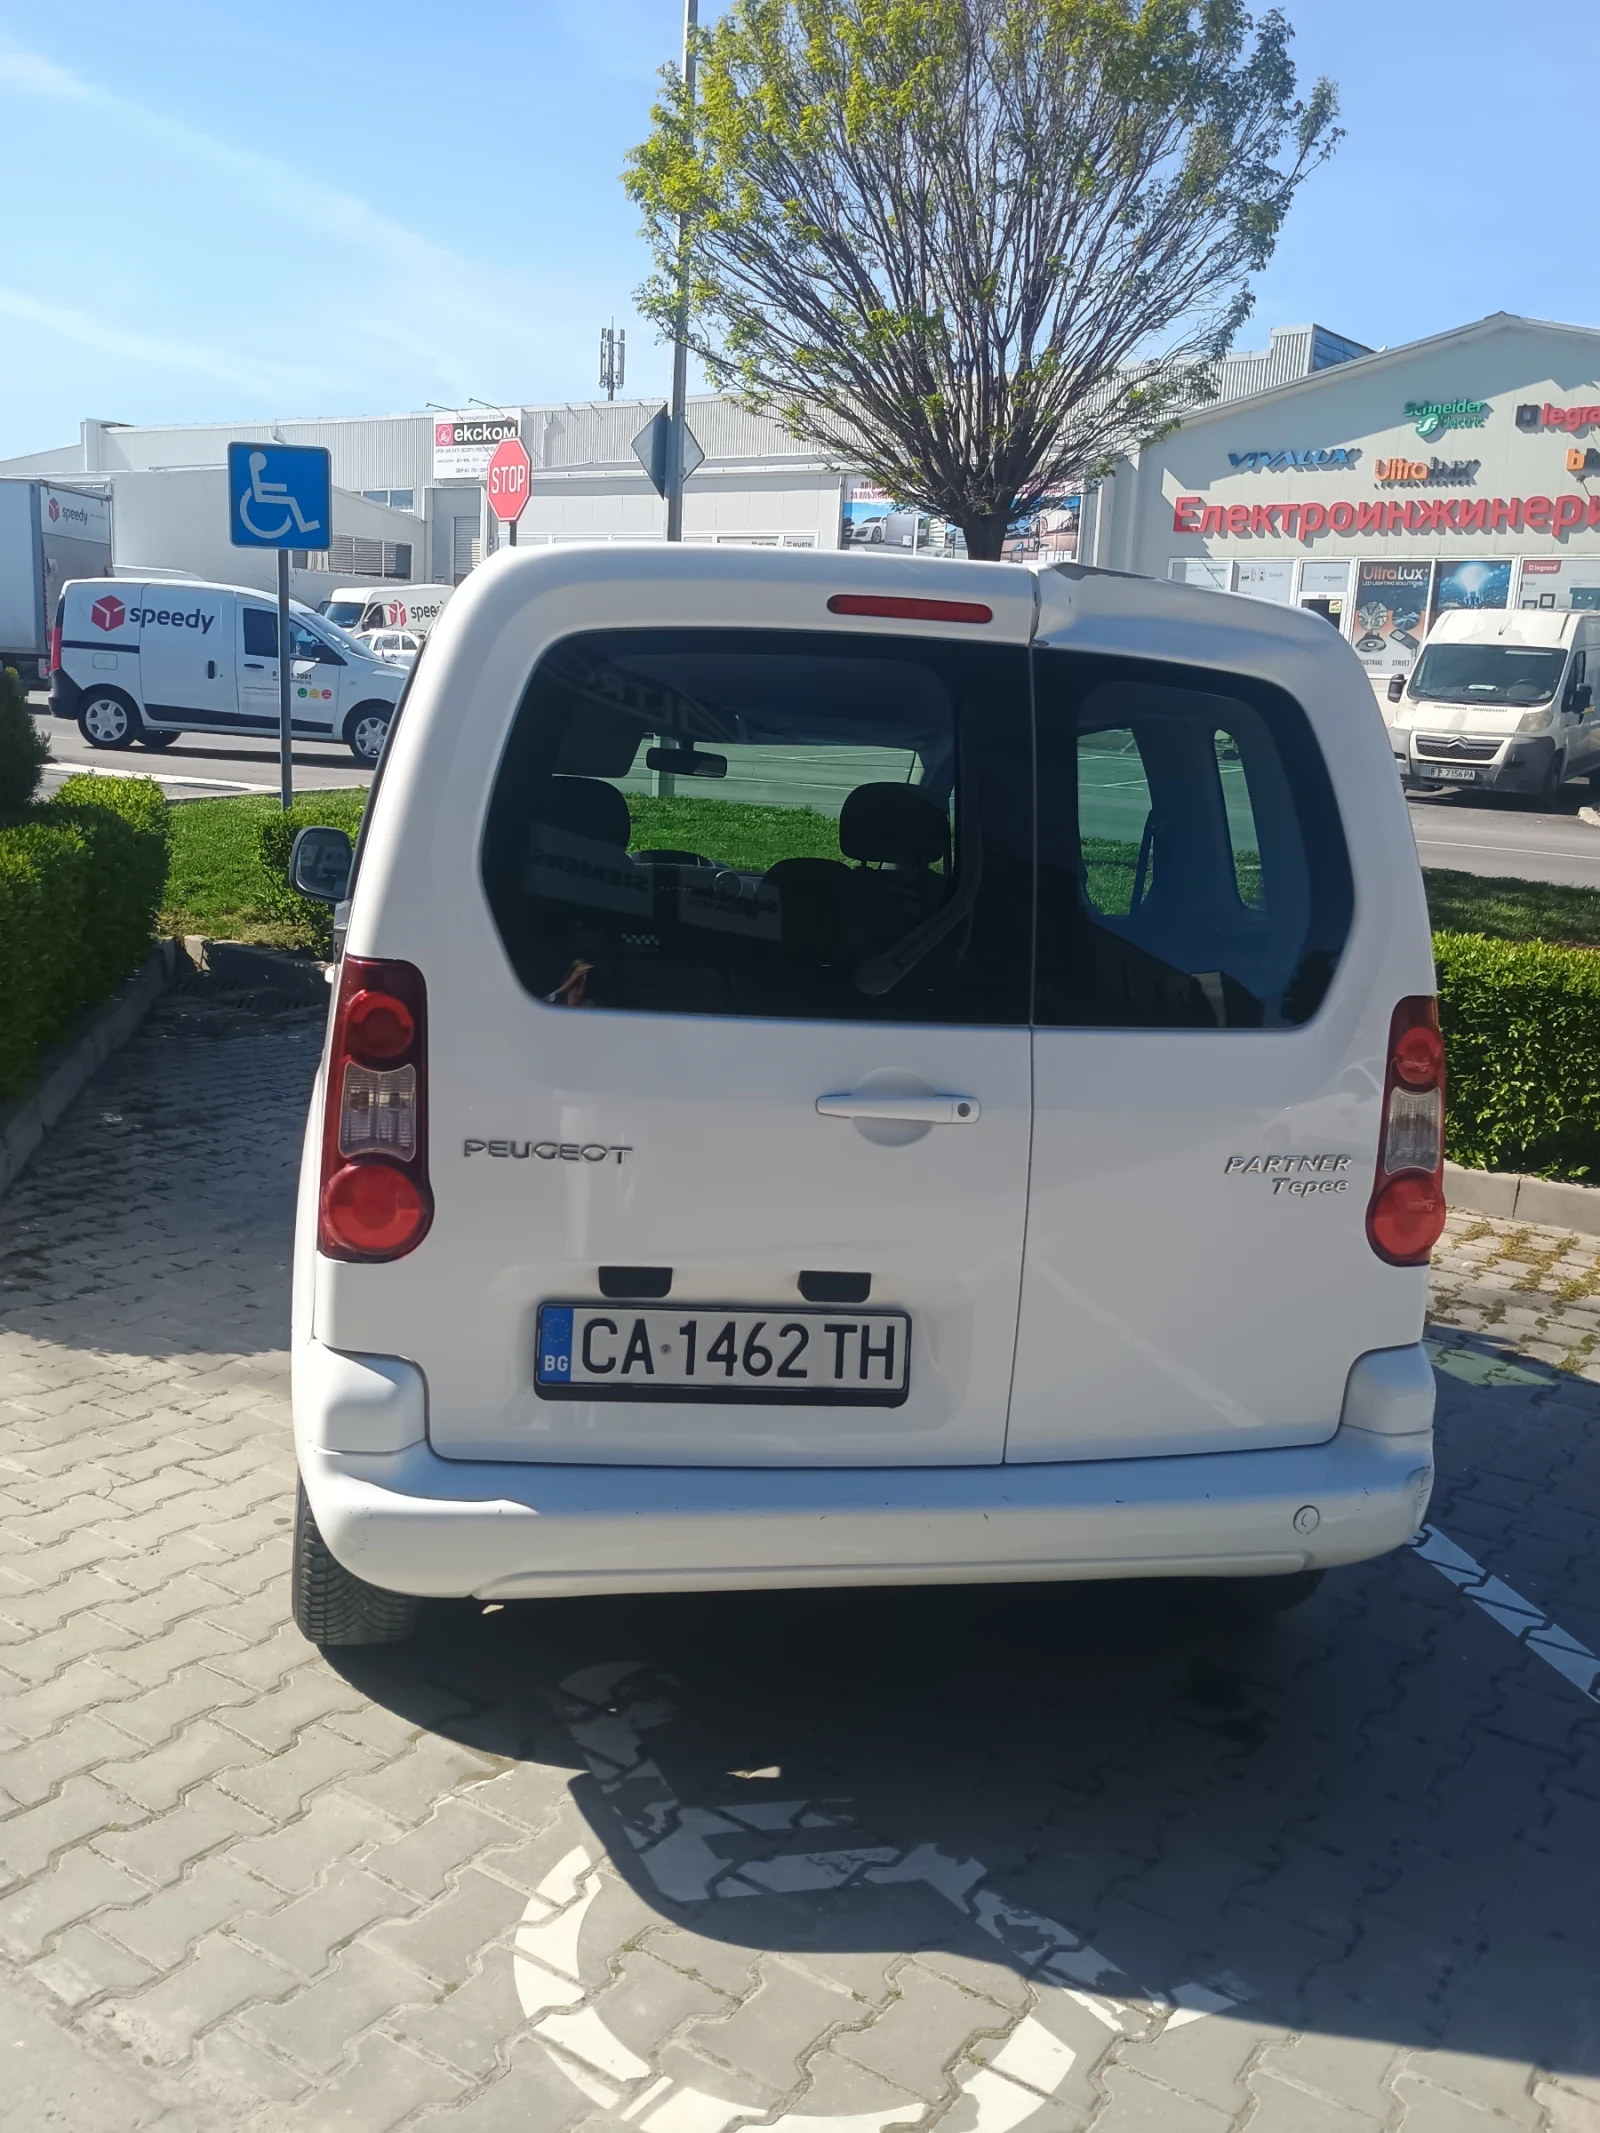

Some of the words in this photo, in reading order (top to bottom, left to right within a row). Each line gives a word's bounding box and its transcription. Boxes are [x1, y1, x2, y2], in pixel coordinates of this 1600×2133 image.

[1404, 399, 1485, 417] Schneider
[1228, 449, 1350, 468] VIVALUX
[491, 464, 526, 496] STOP
[62, 507, 89, 525] speedy
[1363, 566, 1423, 580] UltraLux
[129, 607, 215, 634] speedy
[1391, 659, 1410, 667] STREET
[464, 1139, 633, 1164] PEUGEOT
[1224, 1154, 1353, 1174] PARTNER
[1272, 1177, 1349, 1198] Tepee
[544, 1354, 569, 1372] BG
[582, 1318, 655, 1375] CA
[679, 1320, 810, 1378] 1462
[823, 1323, 896, 1380] TH
